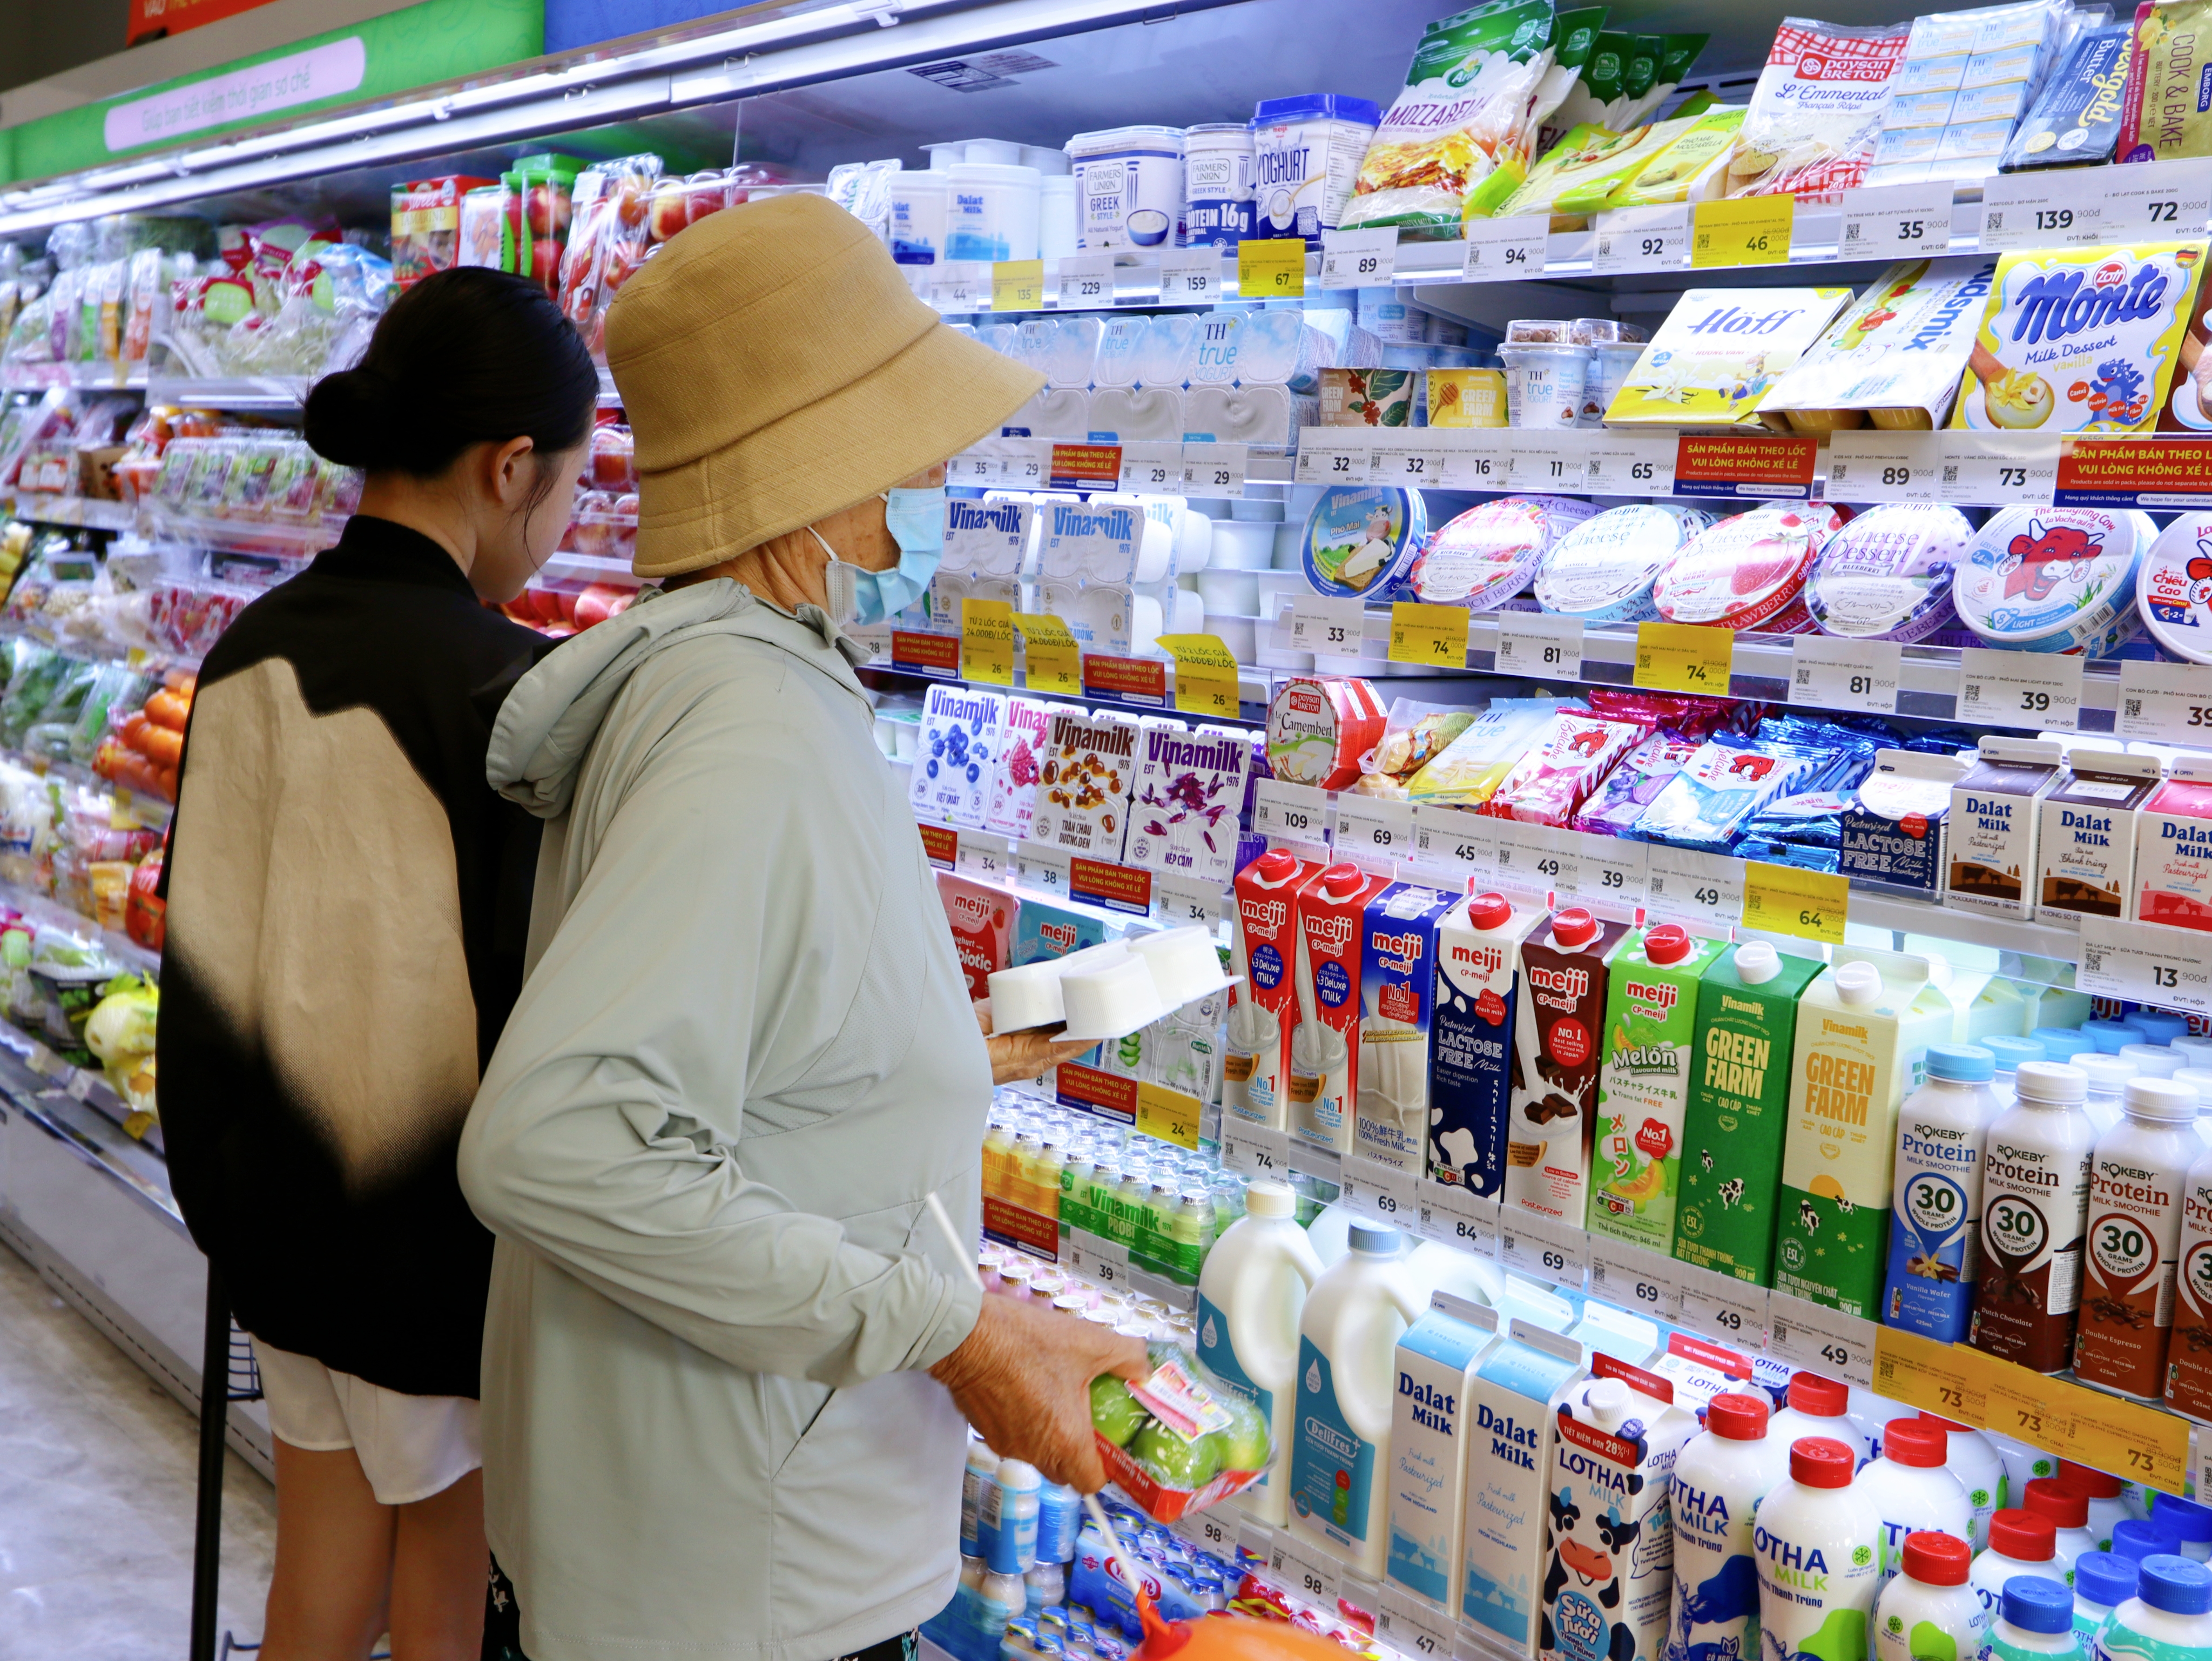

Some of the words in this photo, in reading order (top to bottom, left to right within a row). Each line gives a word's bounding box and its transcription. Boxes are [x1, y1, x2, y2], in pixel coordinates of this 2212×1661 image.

[2080, 38, 2116, 83] Butter
[2167, 33, 2195, 81] COOK
[1452, 65, 1480, 86] Arla
[2165, 85, 2189, 100] &
[2200, 68, 2212, 107] EMBORG
[1384, 92, 1495, 127] MOZZARELLA
[1797, 102, 1835, 111] Français
[2160, 103, 2186, 149] BAKE
[1089, 169, 1121, 183] FARMERS
[1193, 163, 1228, 173] FARMERS
[1197, 172, 1220, 180] UNION
[1256, 149, 1310, 186] YOGHURT
[1094, 181, 1116, 191] UNION
[957, 196, 983, 205] Dalat
[963, 205, 982, 214] Milk
[1090, 197, 1120, 212] GREEK
[400, 210, 446, 226] TAMARIND
[1096, 211, 1114, 220] STYLE
[2036, 209, 2074, 230] 139
[2148, 201, 2179, 222] 72
[1111, 225, 1124, 234] Yogurt
[1898, 220, 1924, 239] 35
[2012, 264, 2168, 344] Monte
[1204, 322, 1228, 341] TH
[1198, 345, 1237, 365] true
[2025, 348, 2058, 365] Milk
[2062, 335, 2117, 358] Dessert
[1195, 366, 1235, 381] YOGURT
[1528, 371, 1543, 381] TH
[1321, 386, 1344, 401] GREEN
[1461, 388, 1497, 403] GREEN
[1527, 381, 1553, 396] true
[2069, 386, 2087, 397] Canxi
[1323, 399, 1341, 413] FARM
[1463, 402, 1494, 417] FARM
[1526, 395, 1552, 404] YOGURT
[2089, 398, 2107, 407] Protein
[1687, 442, 1706, 454] SẢN
[1708, 442, 1735, 454] PHẨM
[1737, 443, 1757, 454] BÁN
[1759, 446, 1785, 455] THEO
[1788, 444, 1806, 455] LỐC
[1709, 455, 1734, 467] LÒNG
[1737, 457, 1770, 468] KHÔNG
[1787, 459, 1798, 469] LẺ
[1882, 467, 1910, 485] 89
[2000, 468, 2026, 486] 73
[950, 501, 1022, 533] Vinamilk
[1054, 507, 1133, 540] Vinamilk
[1008, 536, 1019, 546] 1976
[1118, 543, 1130, 554] 1976
[1842, 564, 1881, 575] BLUEBERRY
[1687, 665, 1706, 681] 74
[930, 689, 999, 726] Vinamilk
[1281, 711, 1333, 737] Camembert
[1053, 716, 1134, 757] Vinamilk
[1148, 732, 1243, 775] Vinamilk
[1225, 775, 1239, 788] 1976
[1966, 798, 2012, 817] Dalat
[1978, 817, 2011, 832] Milk
[2061, 810, 2112, 831] Dalat
[1373, 829, 1391, 845] 69
[1843, 831, 1926, 857] LACTOSE
[2074, 831, 2110, 847] Milk
[1455, 845, 1475, 860] 45
[1843, 850, 1891, 872] FREE
[982, 857, 995, 871] 34
[1537, 859, 1559, 875] 49
[1043, 870, 1056, 884] 38
[954, 893, 990, 917] meiji
[1189, 905, 1205, 920] 34
[1242, 899, 1286, 926] meiji
[1306, 914, 1352, 943] meiji
[1799, 910, 1822, 927] 64
[1041, 922, 1076, 946] meiji
[1247, 923, 1278, 940] CP-meiji
[1311, 939, 1344, 957] CP-meiji
[1372, 932, 1423, 960] meiji
[1452, 945, 1502, 974] meiji
[1530, 967, 1589, 997] meiji
[2153, 966, 2178, 987] 13
[1626, 981, 1678, 1007] meiji
[1823, 1018, 1869, 1040] Vinamilk
[1438, 1030, 1502, 1059] LACTOSE
[1705, 1028, 1771, 1070] GREEN
[1438, 1048, 1473, 1070] FREE
[1704, 1057, 1765, 1100] FARM
[1805, 1052, 1875, 1097] GREEN
[1643, 1098, 1663, 1108] FREE
[1805, 1082, 1868, 1127] FARM
[1171, 1123, 1184, 1137] 24
[1359, 1130, 1373, 1142] 100%
[1374, 1135, 1390, 1148] Fresh
[1391, 1141, 1405, 1152] Milk
[1902, 1134, 1977, 1163] Protein
[1906, 1155, 1924, 1165] MILK
[1926, 1159, 1971, 1173] SMOOTHIE
[1986, 1154, 2059, 1187] Protein
[1916, 1184, 1955, 1213] 30
[2090, 1172, 2170, 1207] Protein
[1089, 1186, 1159, 1233] Vinamilk
[1108, 1218, 1135, 1239] PROBI
[1996, 1206, 2035, 1237] 30
[2101, 1226, 2143, 1257] 30
[1099, 1265, 1113, 1280] 39
[1981, 1306, 2002, 1319] Dutch
[2000, 1312, 2033, 1328] Chocolate
[2085, 1329, 2107, 1342] Double
[2109, 1335, 2142, 1350] Espresso
[1399, 1373, 1455, 1415] Dalat
[1412, 1406, 1453, 1436] Milk
[1477, 1404, 1538, 1450] Dalat
[1564, 1425, 1575, 1436] TIẾT
[1576, 1431, 1591, 1444] KIỆM
[1593, 1438, 1604, 1449] HƠN
[1492, 1438, 1536, 1471] Milk
[1560, 1448, 1626, 1495] LOTHA
[1680, 1507, 1728, 1537] MILK
[1698, 1536, 1722, 1553] Trùng
[1774, 1565, 1828, 1592] MILK
[1796, 1594, 1823, 1608] Trùng
